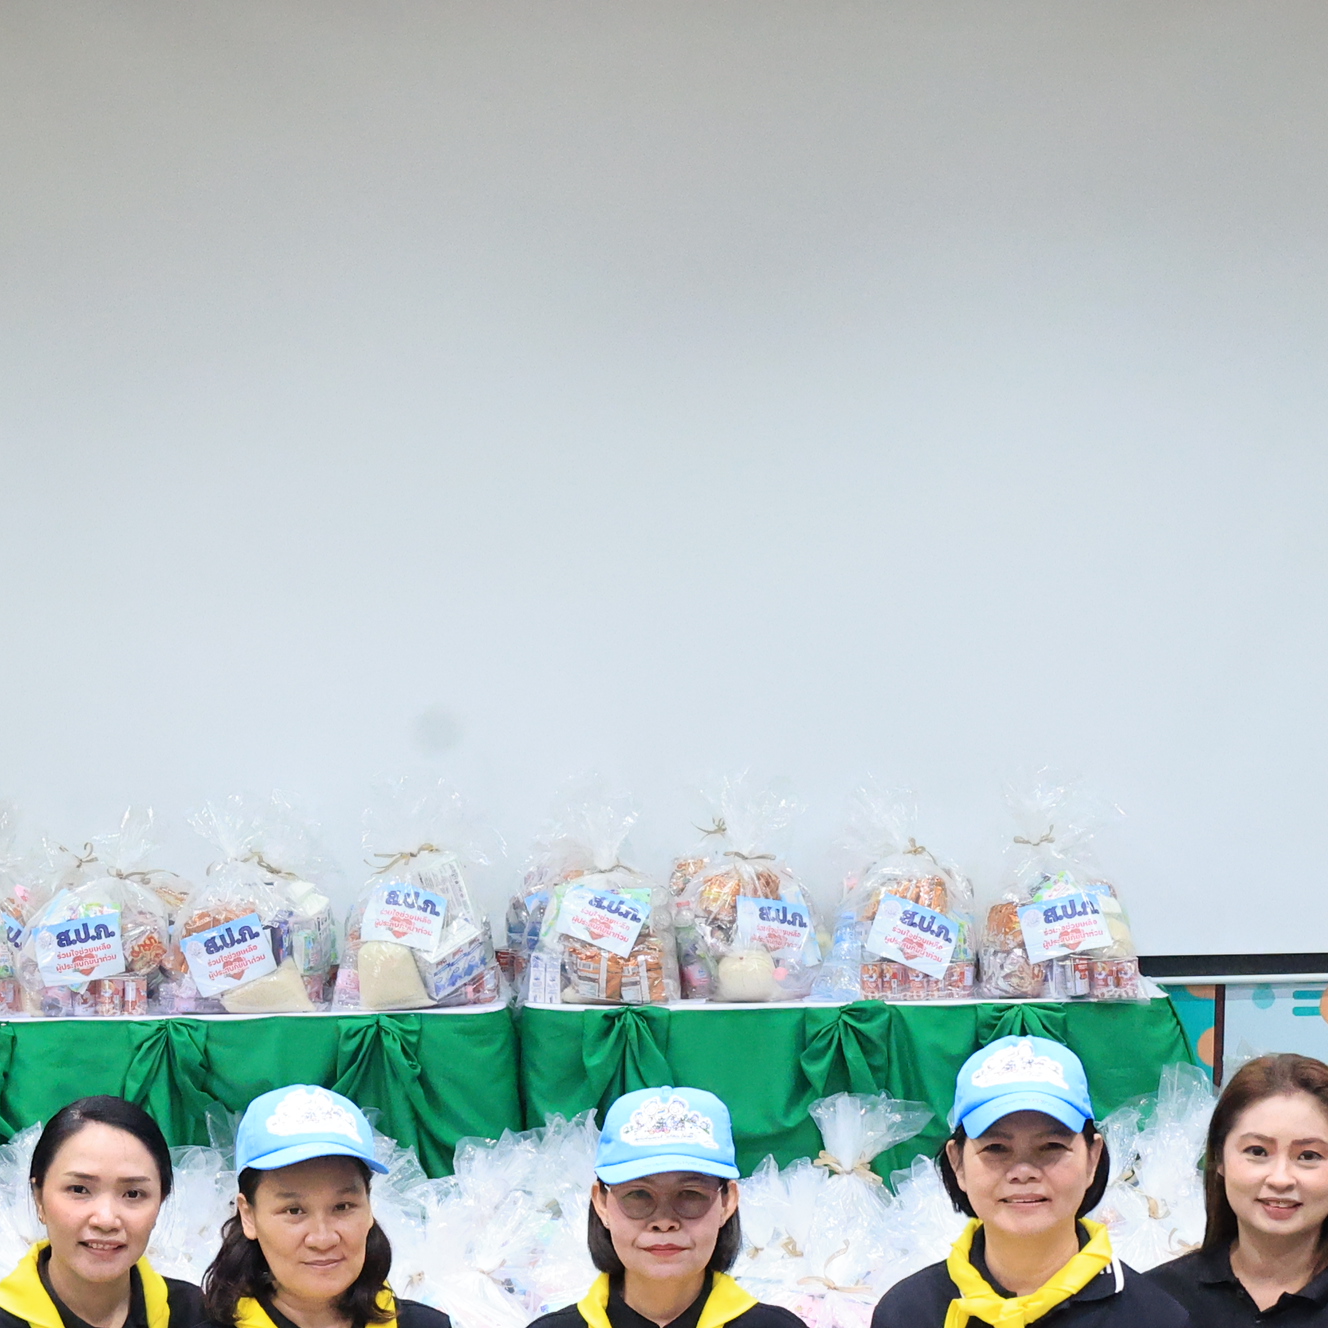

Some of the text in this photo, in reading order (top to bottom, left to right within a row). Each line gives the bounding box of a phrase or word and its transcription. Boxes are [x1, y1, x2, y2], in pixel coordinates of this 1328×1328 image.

[385, 890, 441, 917] ส.ป.ก.
[588, 896, 642, 924] ส.ป.ก.
[1043, 899, 1100, 924] ส.ป.ก.
[759, 906, 808, 928] ส.ป.ก.
[900, 909, 952, 944] ส.ป.ก.
[1043, 919, 1098, 937] ร่วมช่วยเหลือ
[56, 923, 116, 948] ส.ป.ก.
[204, 925, 260, 955] ส.ป.ก.
